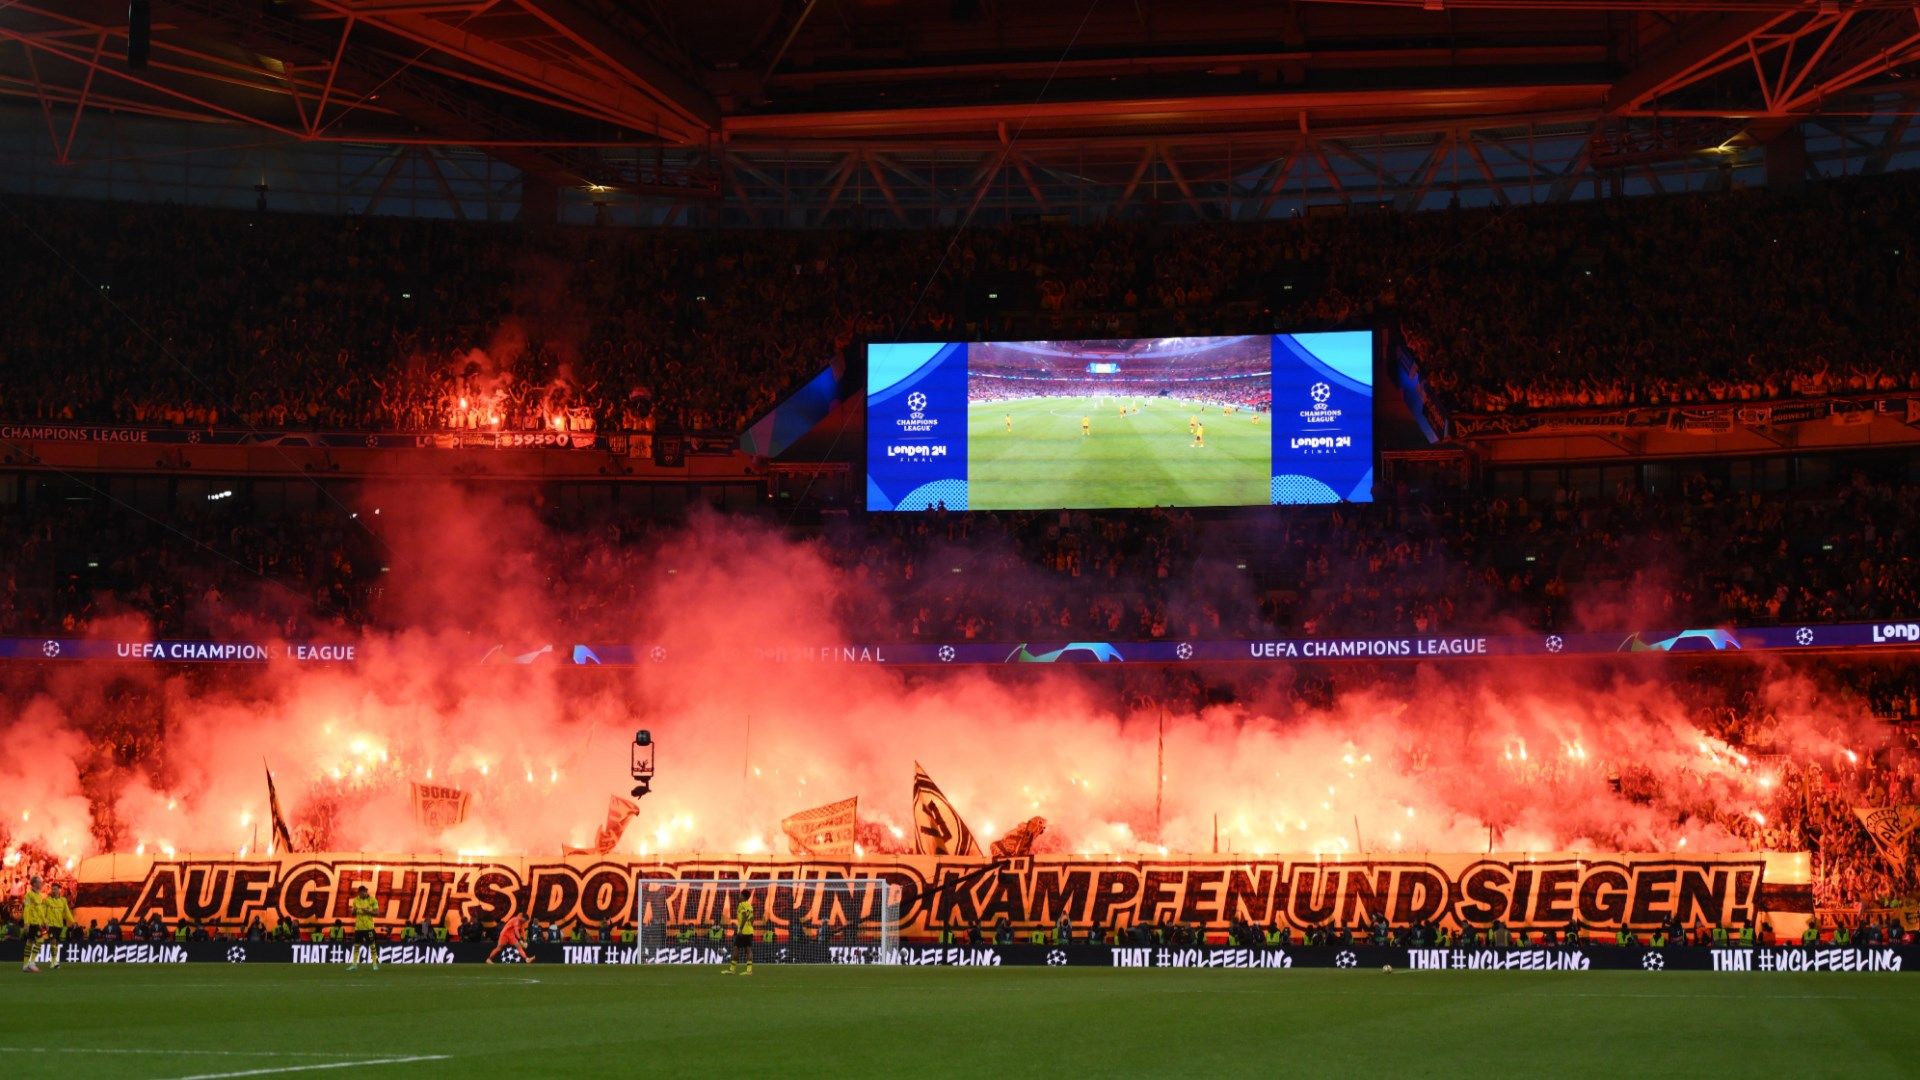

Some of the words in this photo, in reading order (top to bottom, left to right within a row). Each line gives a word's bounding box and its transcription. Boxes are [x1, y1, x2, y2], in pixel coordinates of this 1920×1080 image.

[1, 426, 88, 441] CHAMPIONS
[92, 428, 147, 442] LEAGUE
[1335, 436, 1351, 447] 24
[931, 445, 947, 456] 24
[117, 643, 166, 658] UEFA
[287, 645, 355, 661] LEAGUE
[821, 646, 886, 662] FINAL
[1250, 642, 1298, 658] UEFA
[1302, 640, 1410, 657] CHAMPIONS
[1417, 638, 1487, 655] LEAGUE
[133, 869, 271, 919] AUF
[533, 870, 917, 924] DORTMUND
[934, 860, 1274, 923] KÄMPFEN
[1294, 870, 1444, 924] UND
[1460, 869, 1754, 924] SIEGEN!
[65, 943, 188, 964] #UCLFEELING
[291, 944, 329, 964] THAT
[562, 945, 602, 965] THAT
[1111, 947, 1152, 968] THAT
[1156, 947, 1293, 969] #UCLFEELING
[1407, 949, 1450, 970] THAT
[1451, 948, 1591, 971] #UCLFEELING
[1710, 949, 1754, 972] THAT
[1758, 948, 1903, 972] #UCLFEELING
